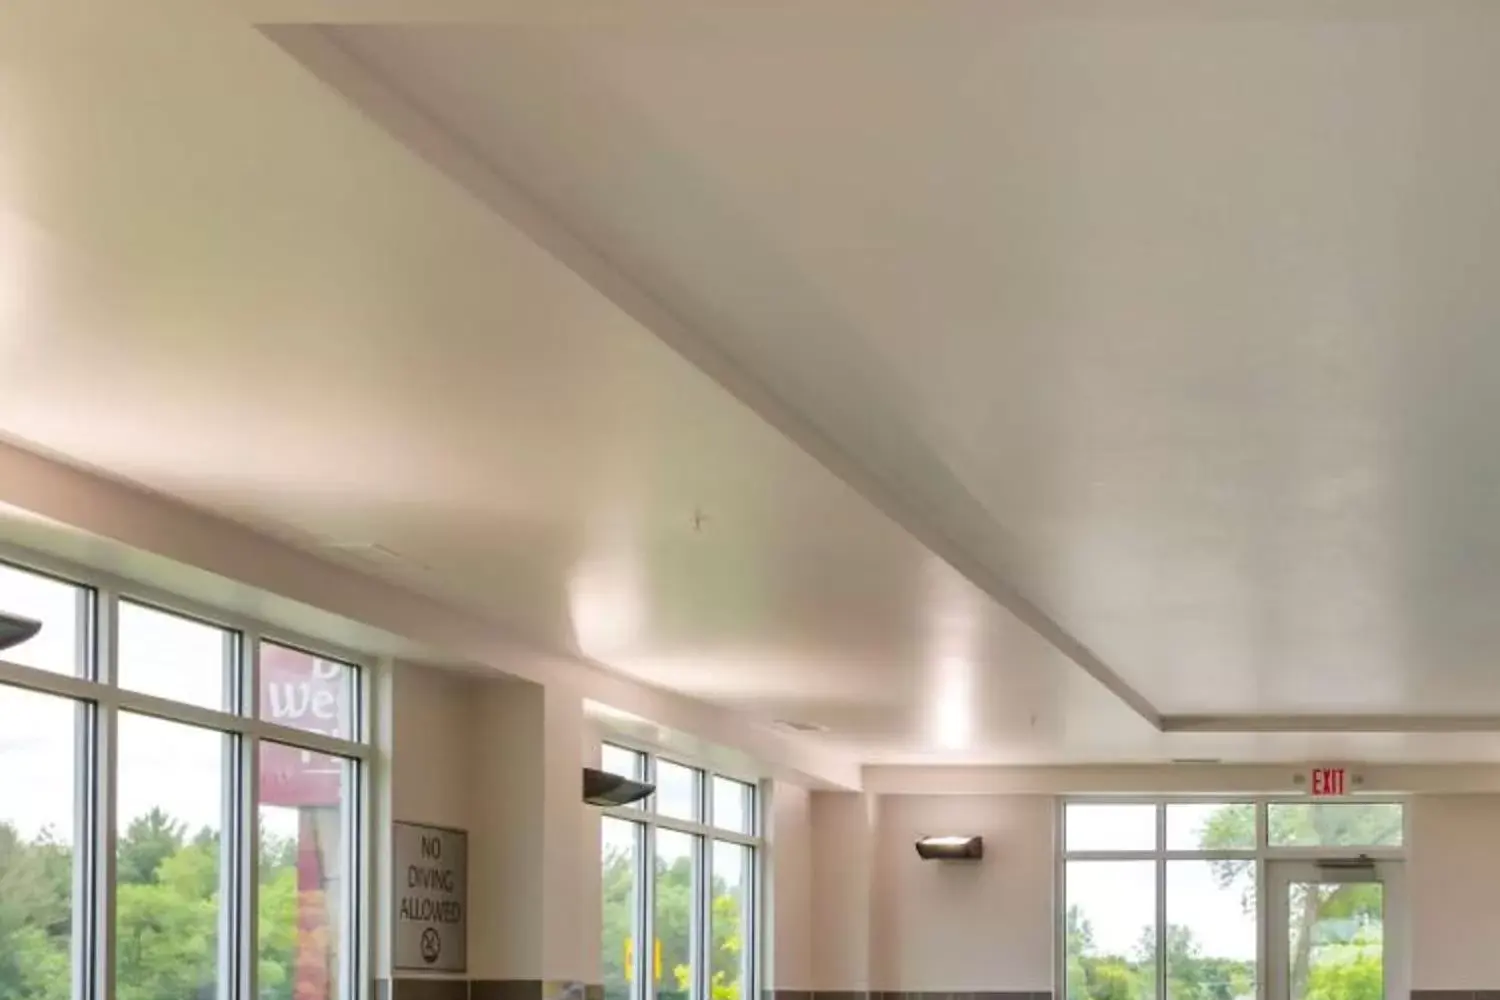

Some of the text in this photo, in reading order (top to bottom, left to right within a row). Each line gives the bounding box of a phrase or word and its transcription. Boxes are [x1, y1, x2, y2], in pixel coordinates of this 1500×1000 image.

[1312, 768, 1345, 796] EXIT
[421, 836, 441, 859] NO
[408, 864, 454, 894] DIVING
[400, 897, 461, 923] ALLOWED
